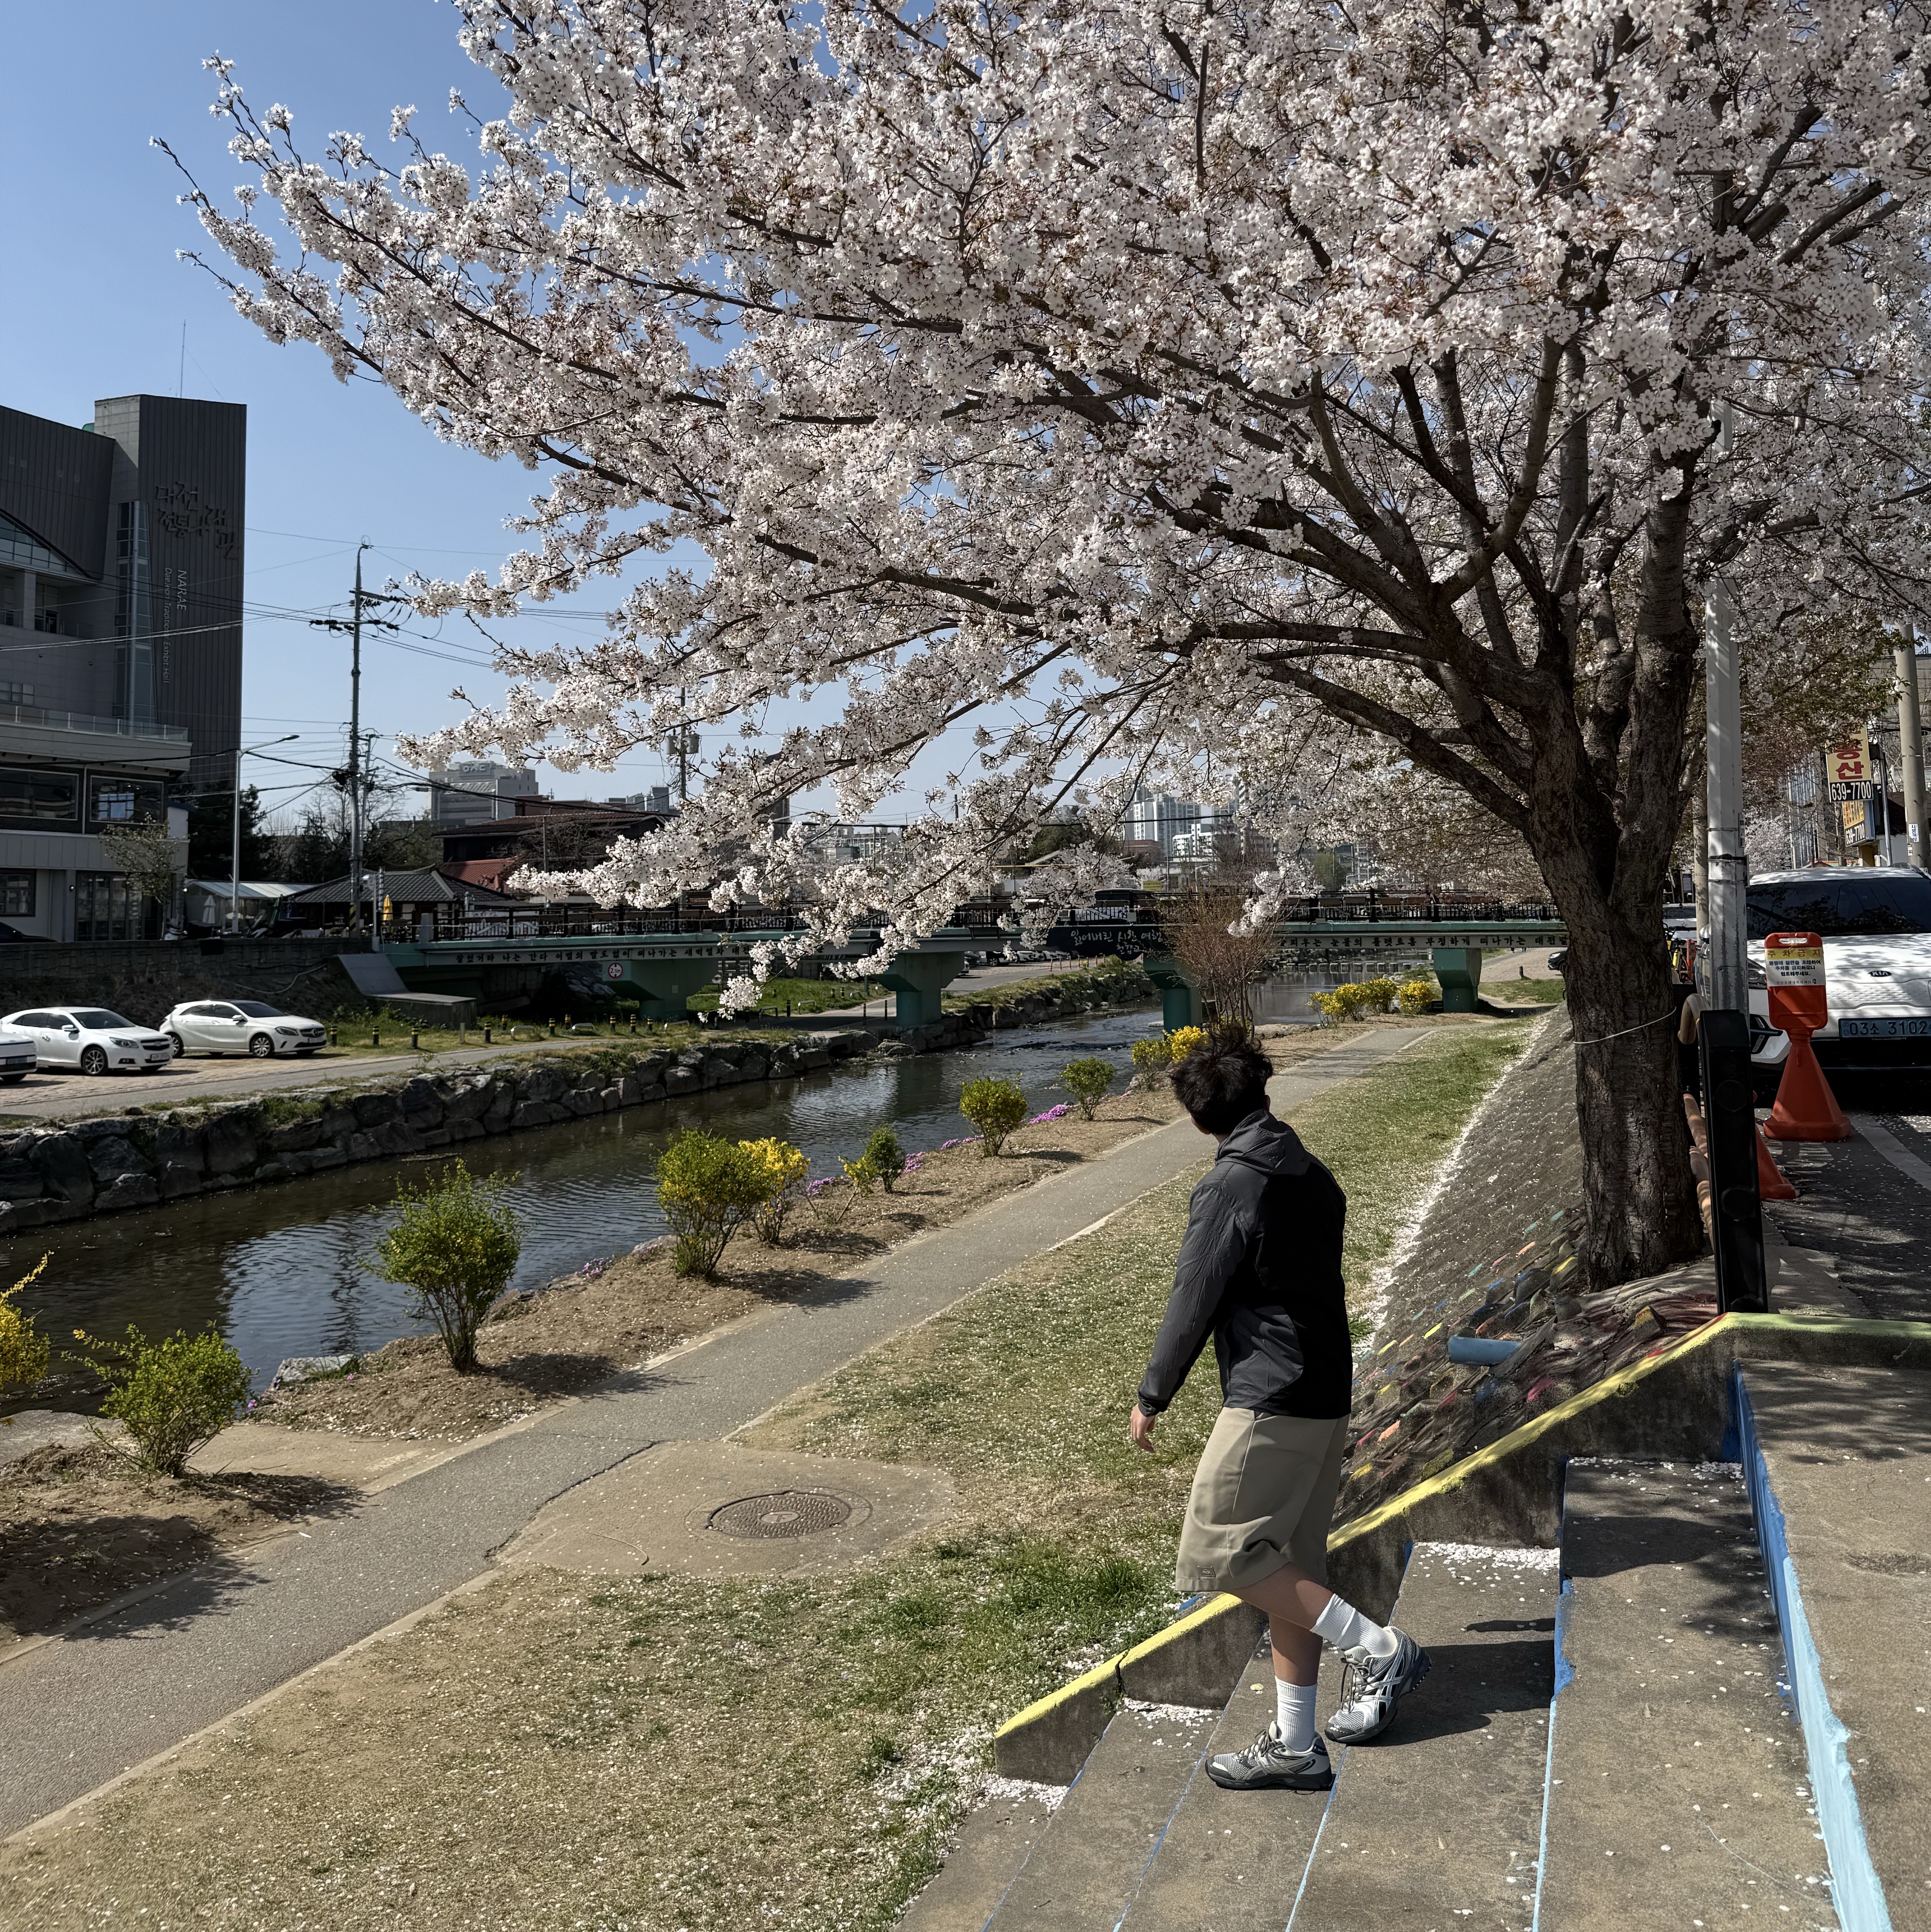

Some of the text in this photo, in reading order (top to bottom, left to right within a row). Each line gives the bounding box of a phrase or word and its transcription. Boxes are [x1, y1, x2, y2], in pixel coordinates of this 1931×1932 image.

[177, 569, 187, 610] NARAE
[1831, 781, 1871, 801] 639-7700
[1330, 937, 1362, 947] 눈물의
[1426, 936, 1470, 946] 무정하게
[1480, 935, 1526, 946] 떠나가는
[503, 953, 521, 962] 나는
[529, 952, 548, 961] 간다
[556, 950, 583, 960] 이별의
[638, 948, 677, 958] 떠나가는
[684, 946, 724, 957] 새벽열차
[1849, 1021, 1928, 1035] 03소 3102
